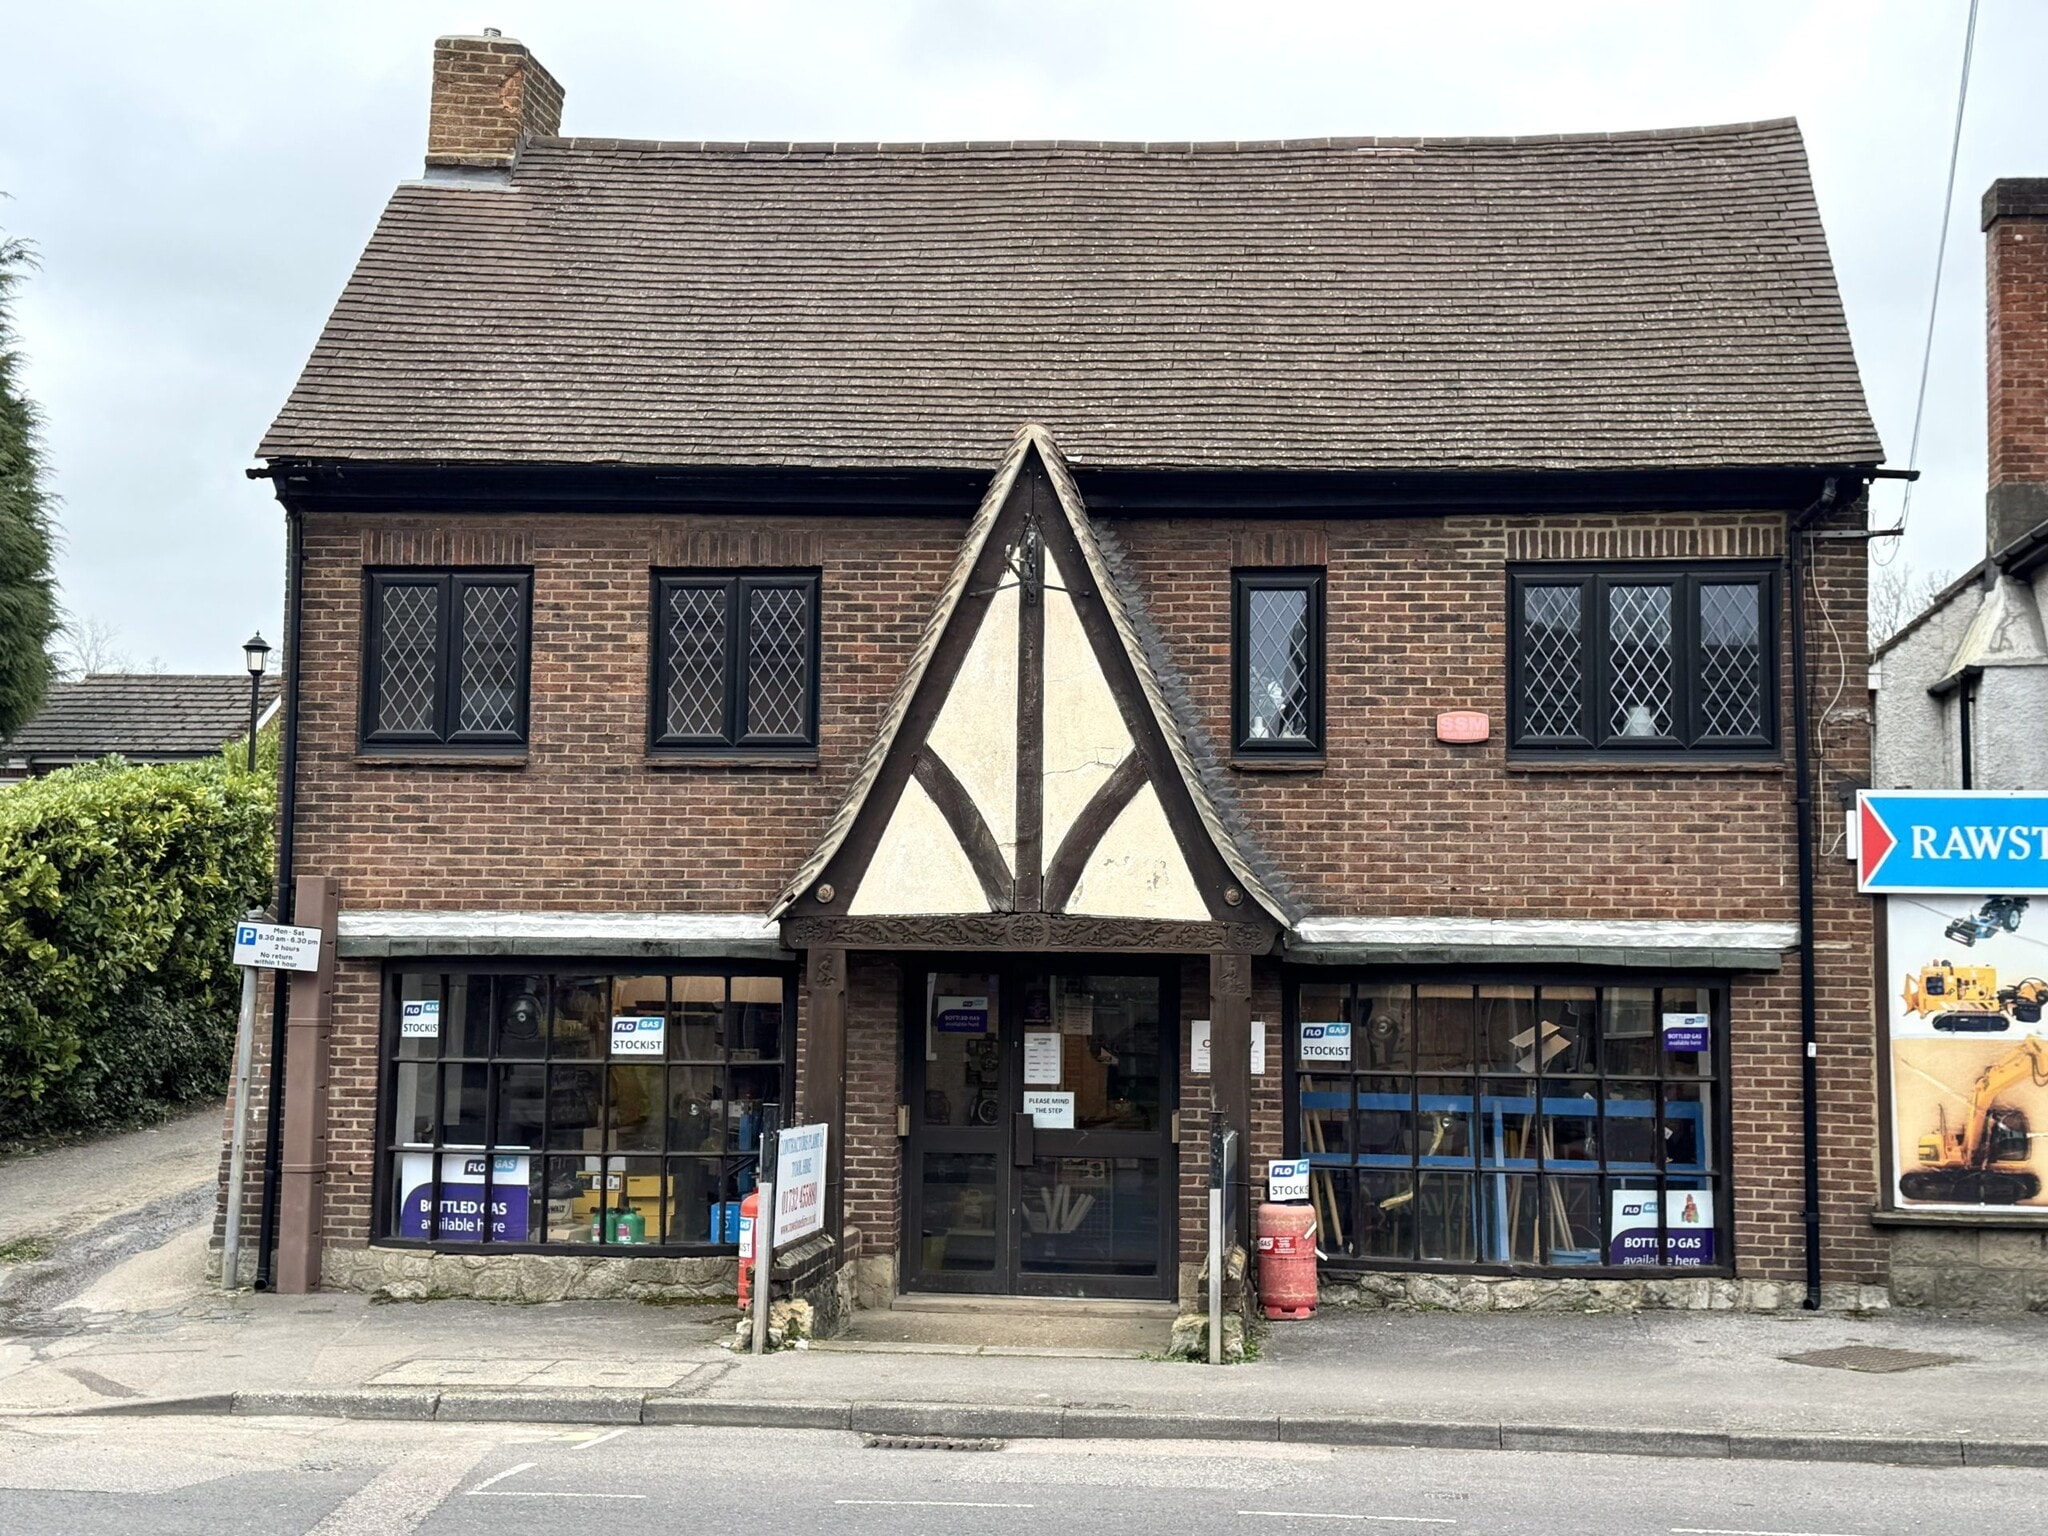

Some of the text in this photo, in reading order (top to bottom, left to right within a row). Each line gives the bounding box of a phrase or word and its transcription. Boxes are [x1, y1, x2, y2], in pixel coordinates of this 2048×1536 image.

[1440, 716, 1486, 730] SSM
[242, 929, 254, 944] P
[273, 927, 288, 935] Mon
[293, 929, 305, 937] Sat
[260, 951, 270, 959] No
[281, 960, 297, 968] hour
[406, 1006, 420, 1014] FLO
[403, 1023, 438, 1032] STOCKIS
[616, 1020, 660, 1031] FLO GAS
[1305, 1026, 1346, 1037] FLO GAS
[613, 1040, 662, 1050] STOCKIST
[1303, 1046, 1349, 1056] STOCKIST
[1028, 1097, 1050, 1105] PLEASE
[467, 1159, 515, 1172] FLO GAS
[1274, 1167, 1293, 1176] FLO
[420, 1199, 478, 1214] BTTLED
[781, 1187, 798, 1215] 01732
[421, 1217, 506, 1233] avilable hre
[1624, 1237, 1701, 1248] BOTTLD GAS
[1623, 1254, 1700, 1266] availae here
